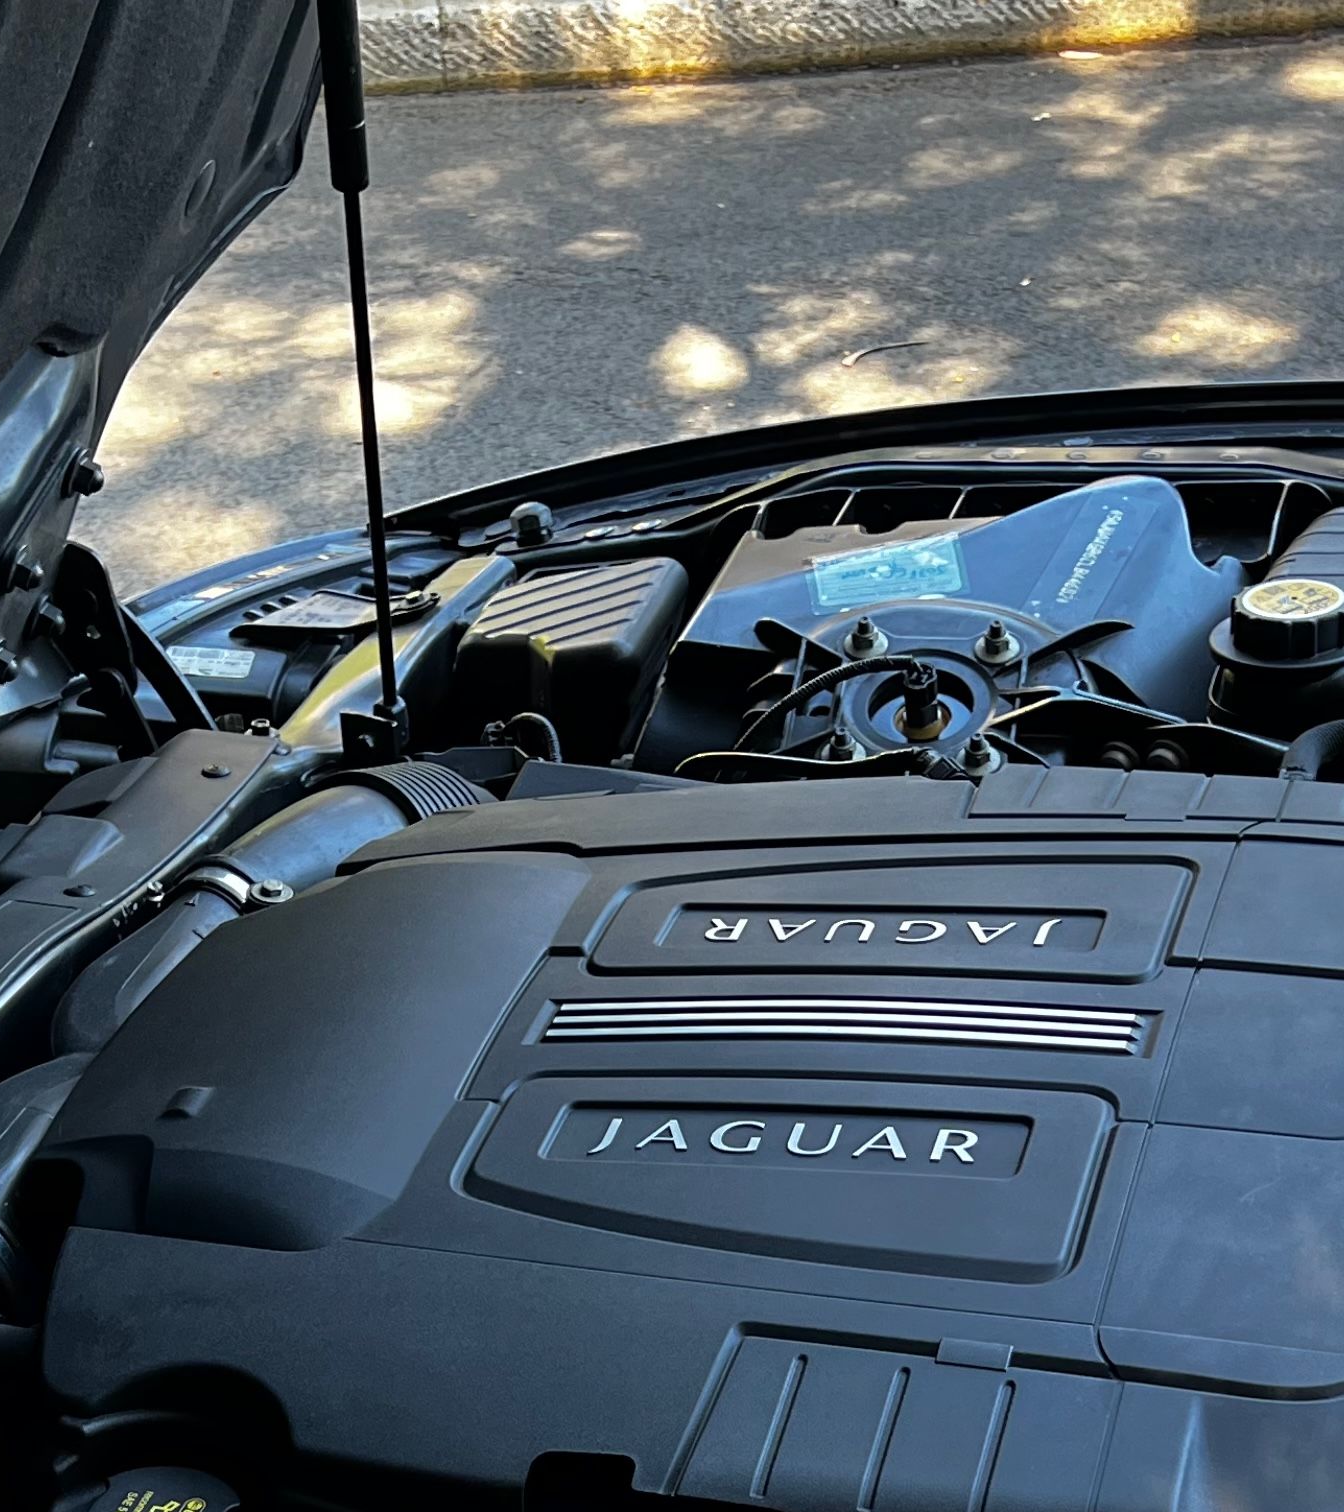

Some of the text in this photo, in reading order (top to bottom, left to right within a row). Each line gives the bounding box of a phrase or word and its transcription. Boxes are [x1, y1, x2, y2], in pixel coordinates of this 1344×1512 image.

[705, 916, 1061, 946] JAGUAR
[586, 1117, 978, 1164] JAGUAR
[122, 1491, 139, 1507] SAE
